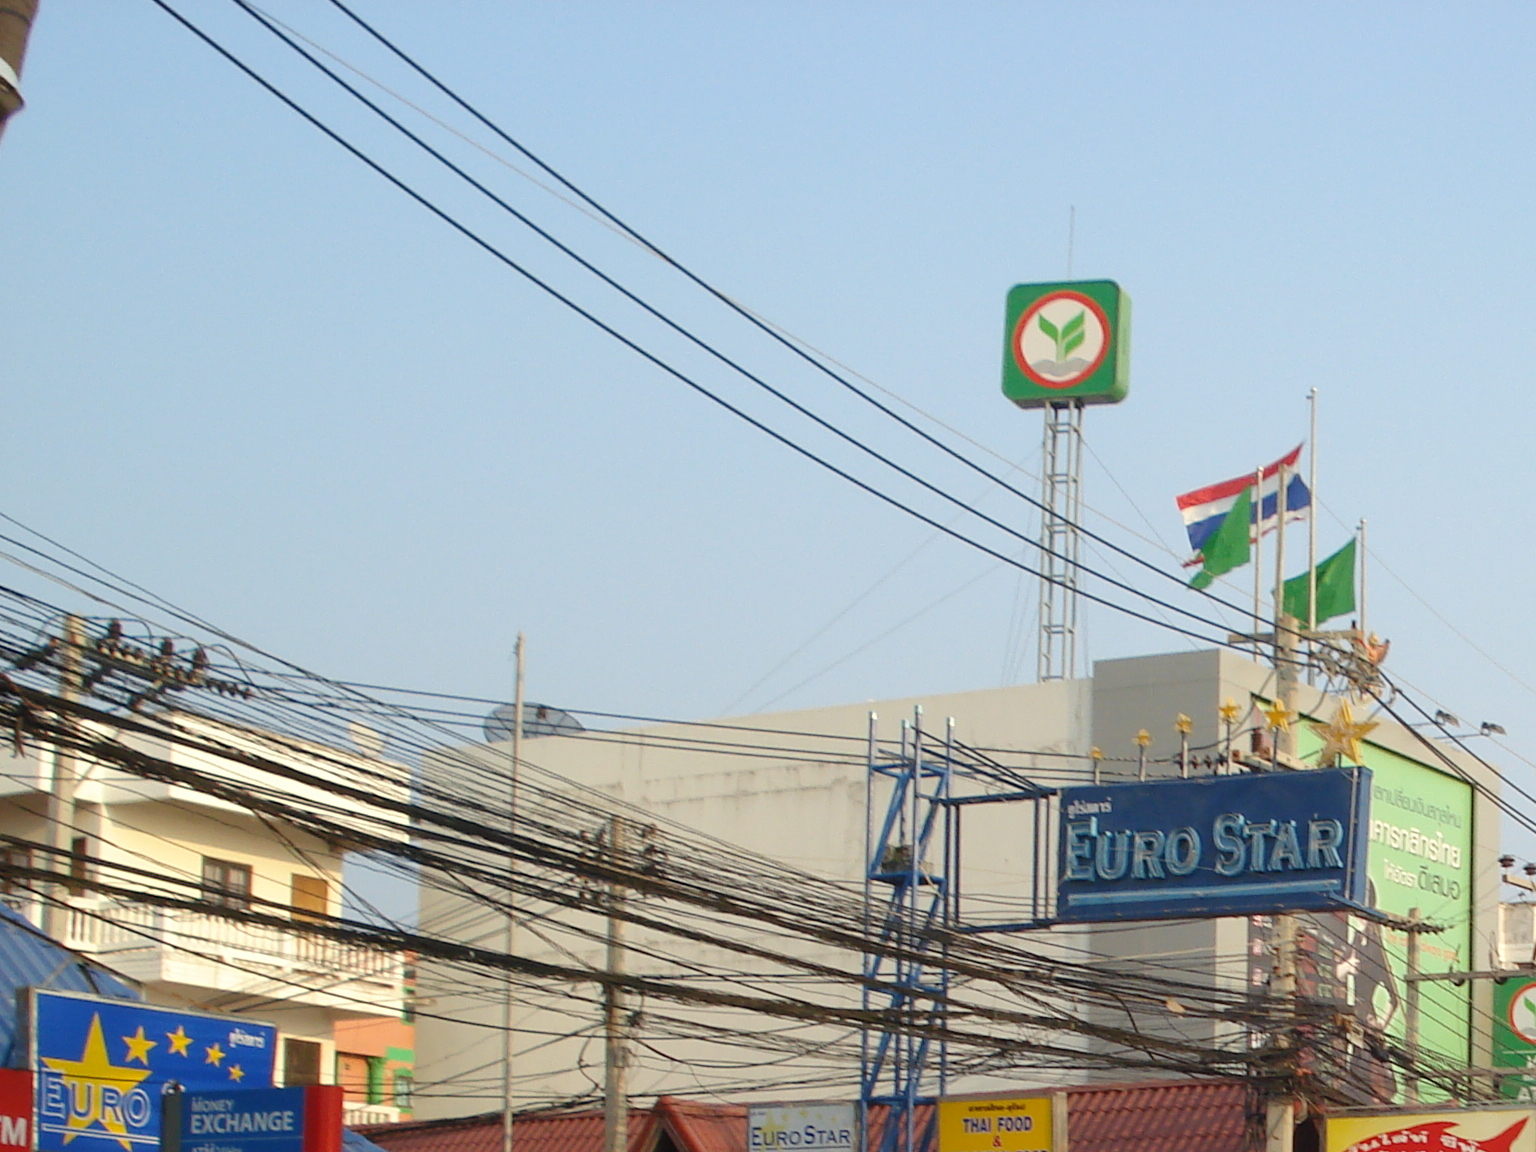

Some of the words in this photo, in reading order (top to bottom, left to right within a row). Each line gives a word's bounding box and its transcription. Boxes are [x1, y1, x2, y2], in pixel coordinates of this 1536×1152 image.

[1065, 816, 1201, 882] EURO
[1212, 812, 1344, 877] STAR
[41, 1067, 150, 1128] EURO
[191, 1098, 234, 1112] MONEY
[0, 1114, 28, 1148] M
[190, 1111, 294, 1134] EXCHANGE
[963, 1117, 991, 1133] THAI
[998, 1116, 1032, 1132] FOOD
[993, 1135, 1002, 1147] &
